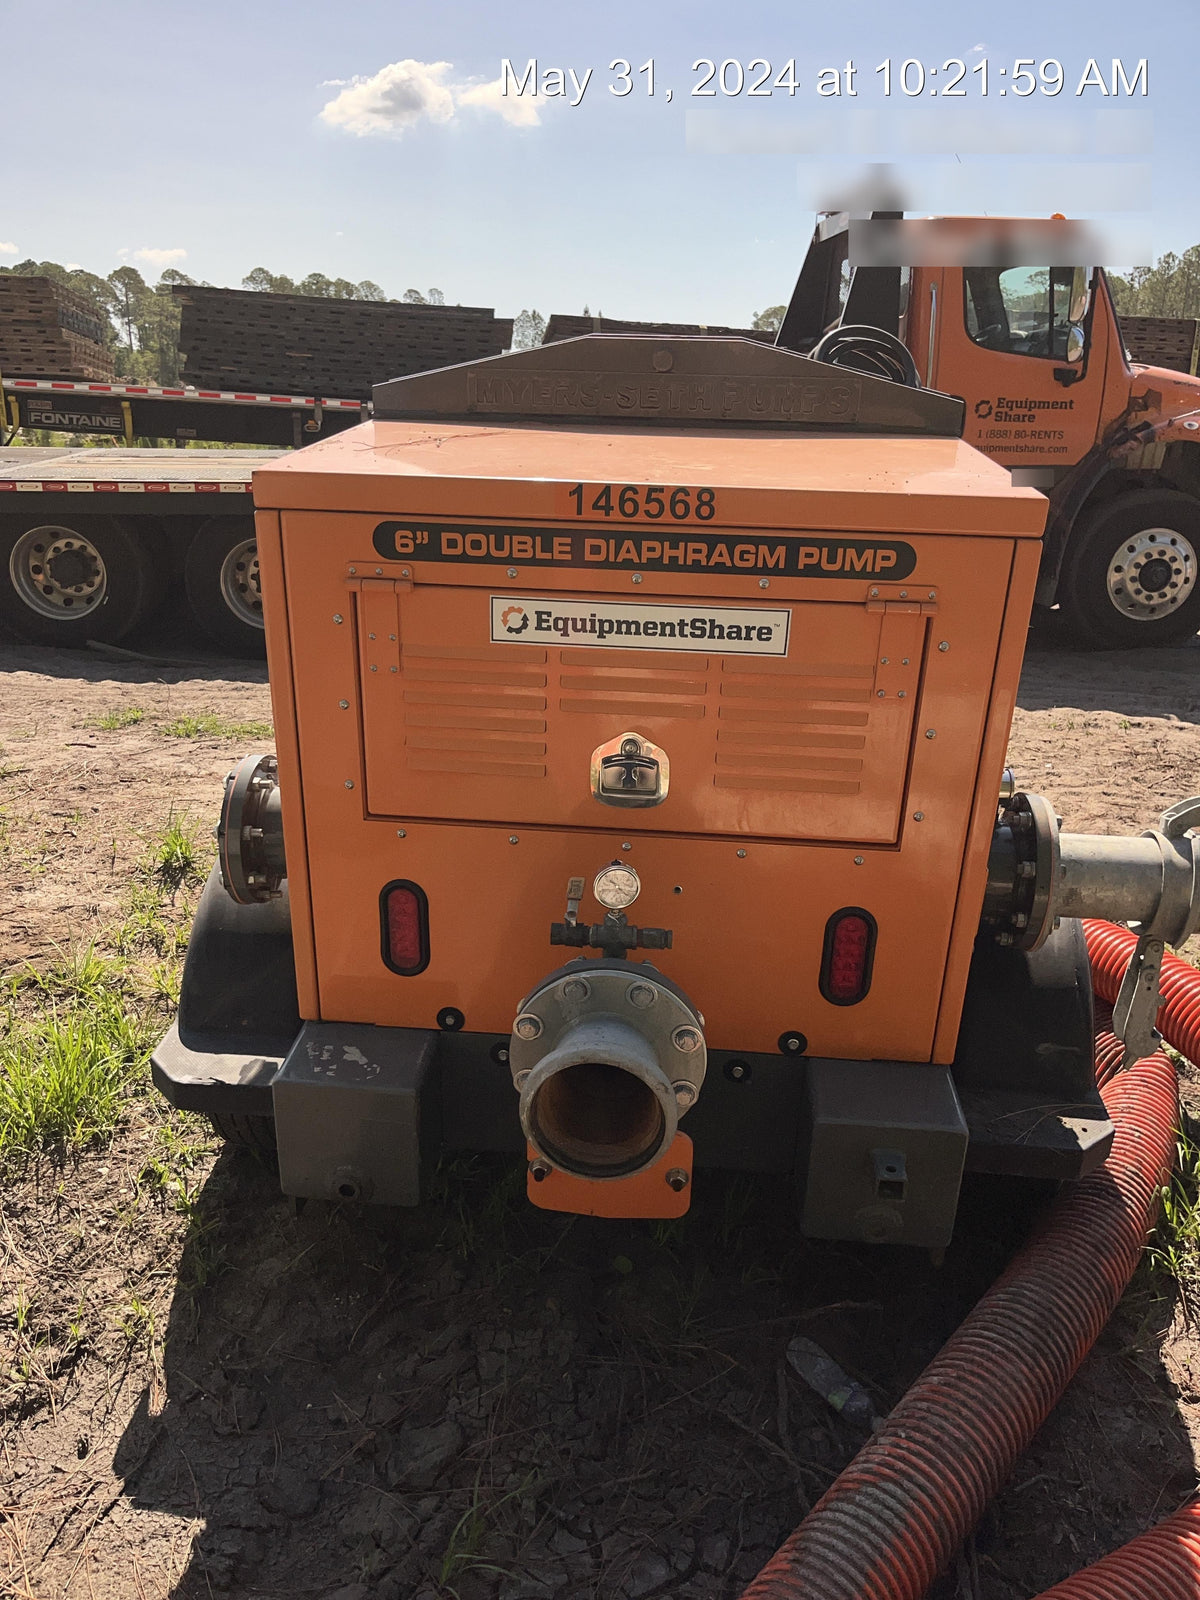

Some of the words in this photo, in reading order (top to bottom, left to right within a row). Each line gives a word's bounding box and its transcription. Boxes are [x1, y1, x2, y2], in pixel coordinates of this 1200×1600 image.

[475, 377, 713, 411] MYERS-SETH
[722, 384, 852, 415] PUMPS
[996, 397, 1075, 412] Equipment
[30, 412, 121, 428] FONTAINE
[994, 411, 1036, 423] Share
[977, 430, 983, 439] 1
[985, 430, 1011, 439] (888)
[1014, 430, 1064, 440] 80-RENTS
[569, 484, 716, 520] 146568
[441, 532, 572, 561] DOUBLE
[583, 538, 787, 569] DIAPHRAGM
[797, 547, 898, 574] PUMP
[535, 611, 772, 641] EquipmentShare
